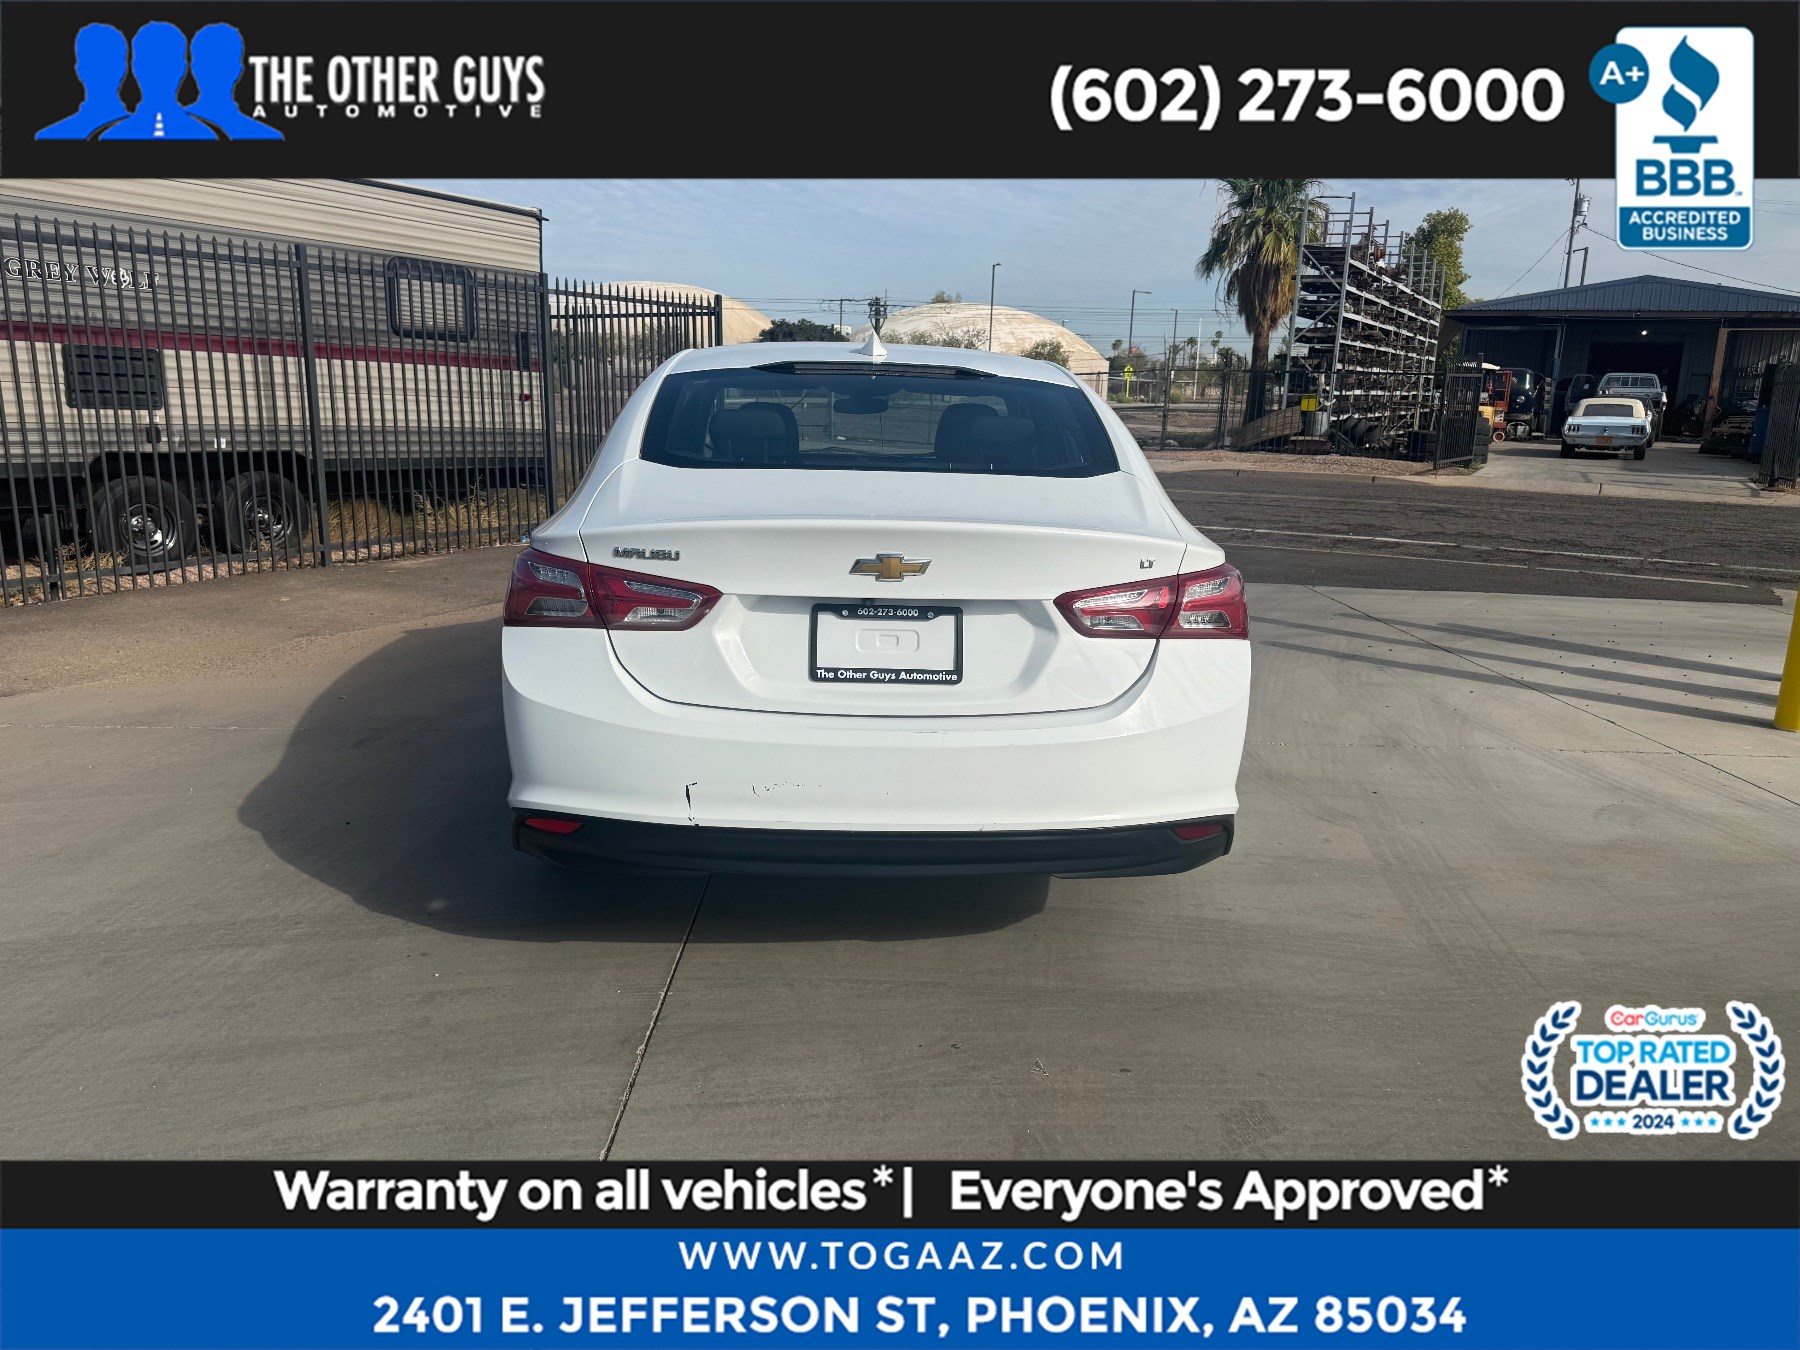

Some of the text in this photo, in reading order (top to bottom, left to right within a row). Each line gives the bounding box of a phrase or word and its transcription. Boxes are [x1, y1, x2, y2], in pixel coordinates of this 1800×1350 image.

[3, 257, 79, 283] GREY
[612, 546, 680, 561] MALIBU
[857, 607, 919, 617] 602-273-6000
[816, 669, 958, 682] The Other Guys Automotive
